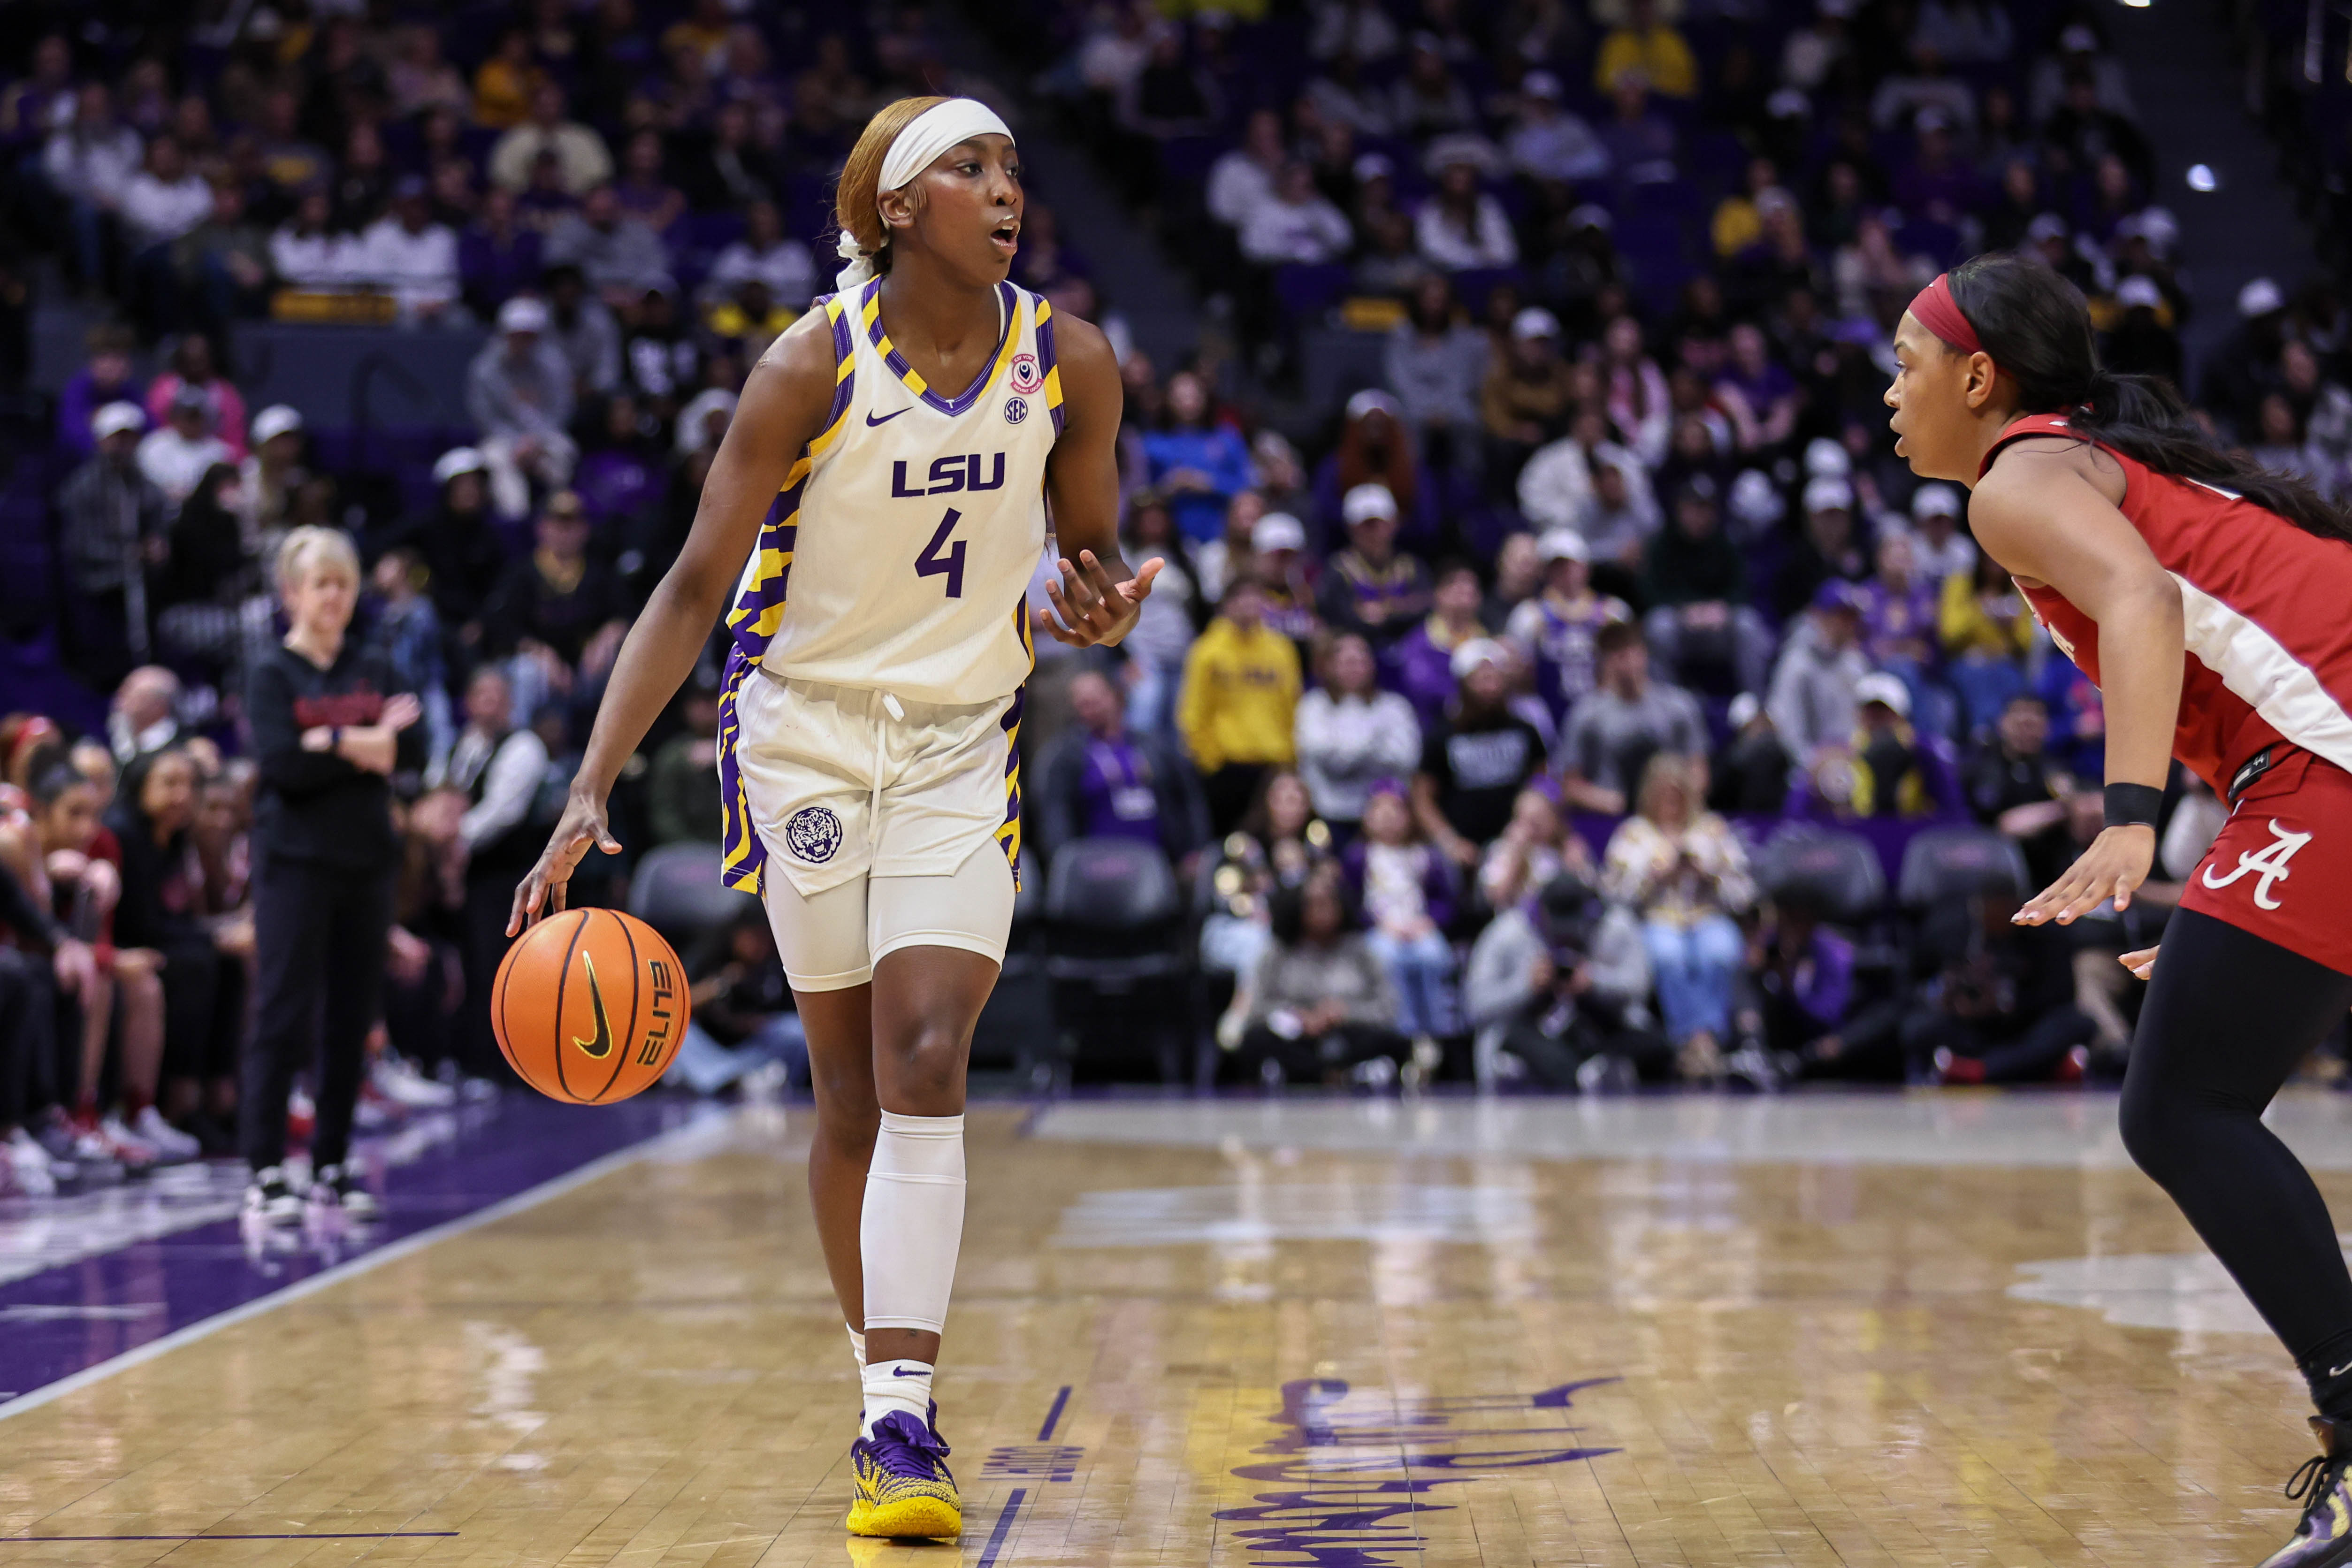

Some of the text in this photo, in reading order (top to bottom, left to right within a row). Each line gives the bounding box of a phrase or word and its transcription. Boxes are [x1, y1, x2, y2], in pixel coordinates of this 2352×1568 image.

[1007, 400, 1025, 421] SEC
[1013, 383, 1029, 393] SERVANT
[892, 452, 1005, 497] LSU
[915, 507, 967, 598] 4
[2202, 818, 2313, 910] A
[636, 959, 672, 1065] ELITE
[977, 1445, 1086, 1482] COURT
